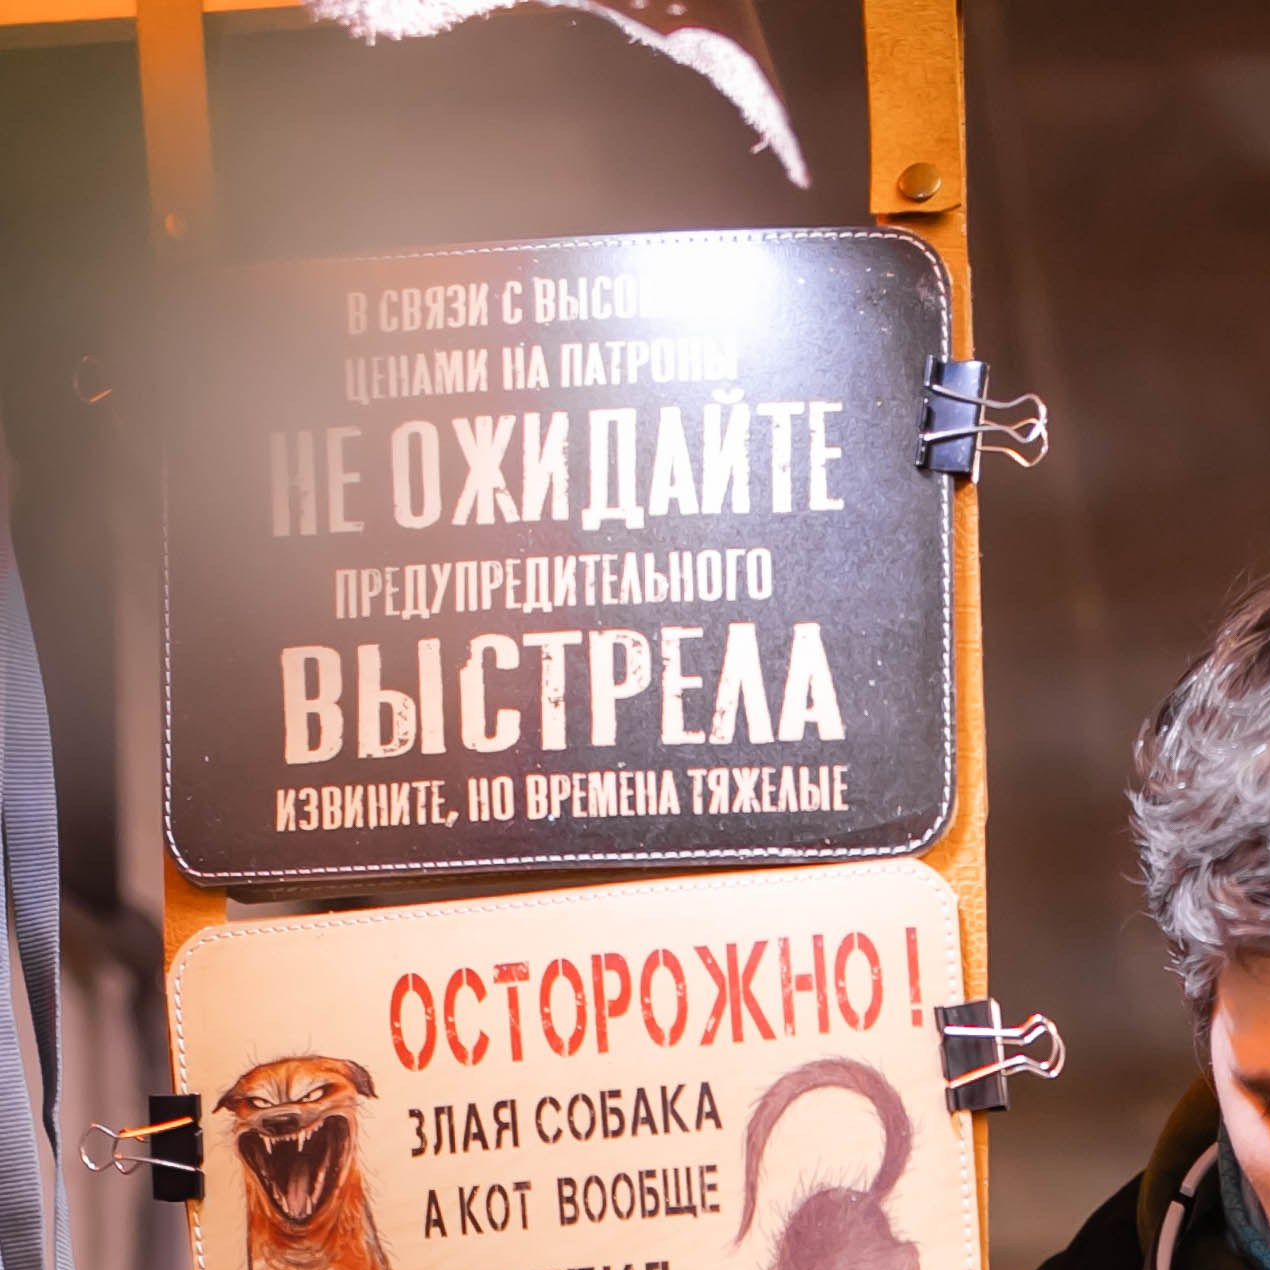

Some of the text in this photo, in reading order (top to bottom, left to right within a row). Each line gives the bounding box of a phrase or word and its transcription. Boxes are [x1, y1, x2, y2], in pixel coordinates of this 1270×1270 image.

[346, 292, 367, 335] В
[379, 283, 488, 333] СВЯЗИ
[502, 281, 522, 324] С
[345, 335, 741, 406] ЦЕНАМИ НА ПАТРОНЫ
[268, 388, 845, 538] НЕ ОЖИДАЙТЕ
[334, 548, 773, 621] ПРЕДУПРЕДИТЕЛЬНОГО
[279, 622, 846, 765] ВЫСТРЕЛА
[273, 764, 849, 832] ИЗВИНИТЕ, НО ВРЕМЕНА ТЯЖЕЛЫЕ
[390, 926, 923, 1072] ОСТОРОЖНО!
[408, 1081, 723, 1158] ЗЛАЯ СОБАКА
[423, 1164, 721, 1239] А КОТ ВООБЩЕ
